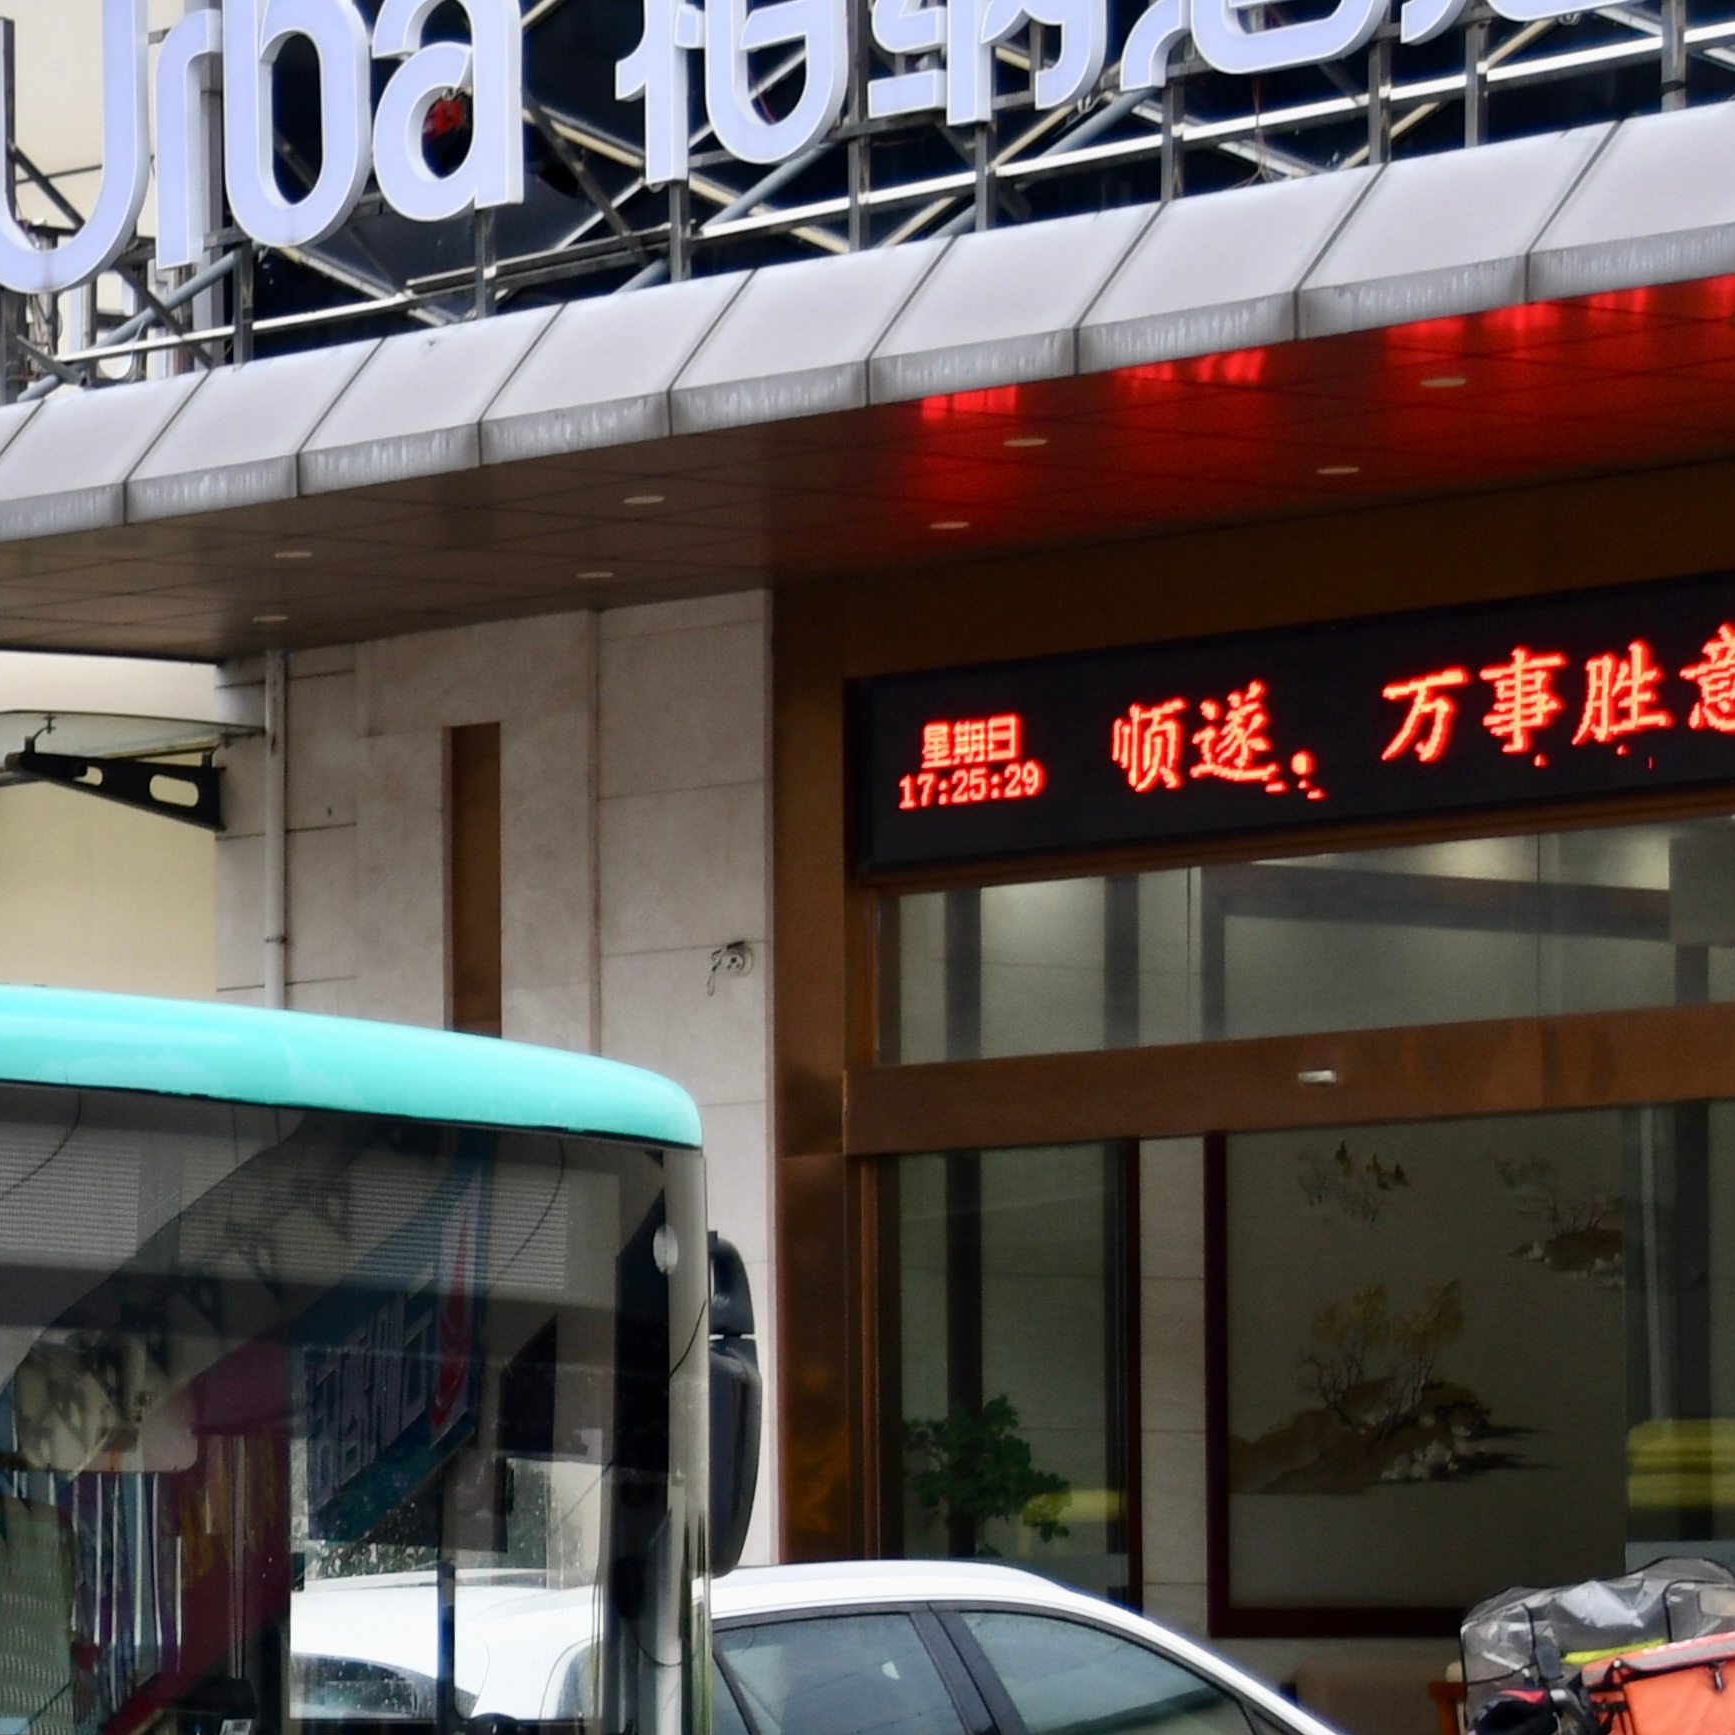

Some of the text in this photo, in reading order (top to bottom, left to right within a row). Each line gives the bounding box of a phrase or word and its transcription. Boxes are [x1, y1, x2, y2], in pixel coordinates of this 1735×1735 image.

[920, 714, 1021, 769] 星期日
[898, 761, 1046, 810] 17:25:29
